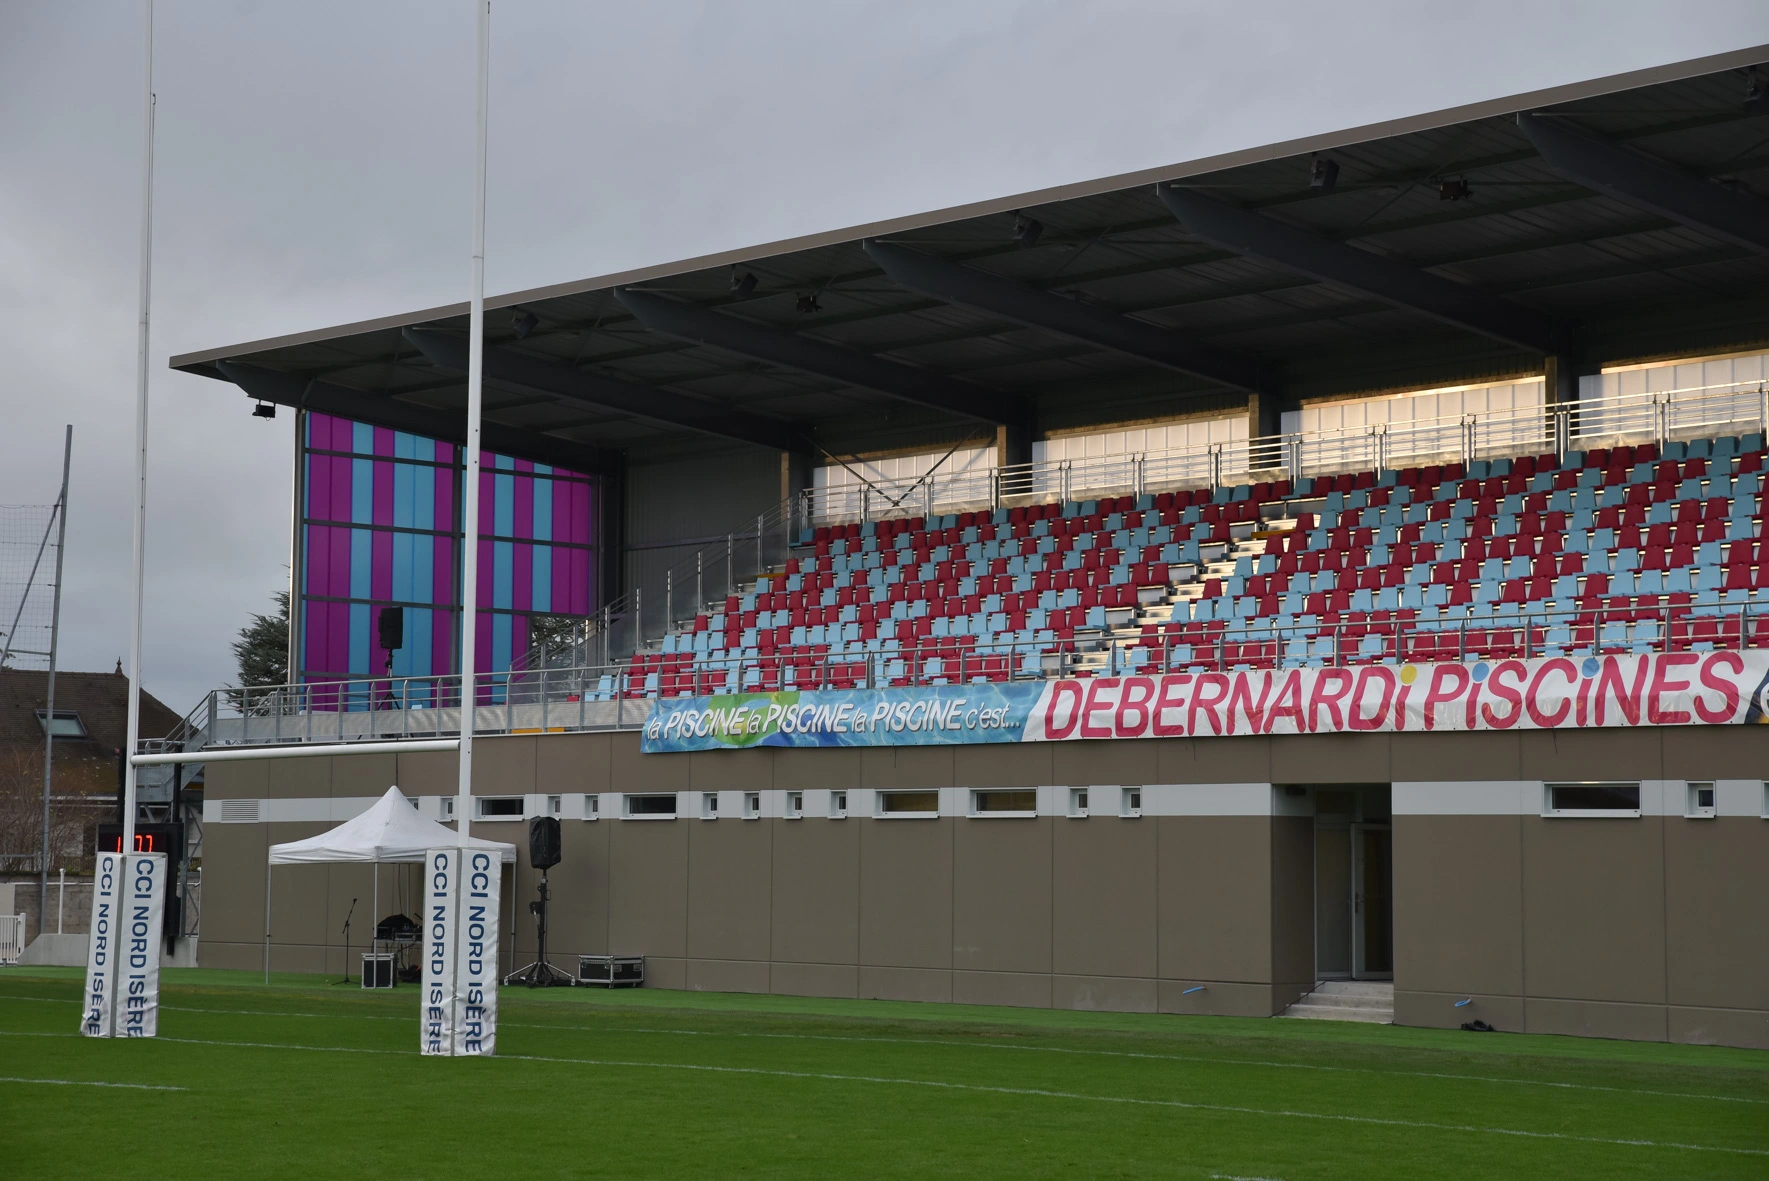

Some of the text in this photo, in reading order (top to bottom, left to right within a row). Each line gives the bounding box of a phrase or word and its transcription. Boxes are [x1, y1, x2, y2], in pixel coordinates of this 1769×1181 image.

[647, 716, 662, 740] la
[663, 706, 749, 739] PISCINE
[746, 709, 762, 734] la
[762, 703, 854, 735] PISCINE
[851, 707, 868, 733] la
[870, 699, 967, 733] PISCINE
[100, 857, 114, 896] CCI
[134, 859, 154, 899] CCI
[433, 854, 448, 898] CCI
[95, 904, 110, 966] NORD
[129, 906, 150, 969] NORD
[431, 905, 446, 976] NORD
[465, 854, 490, 1053] CCI NORD ISÈRE
